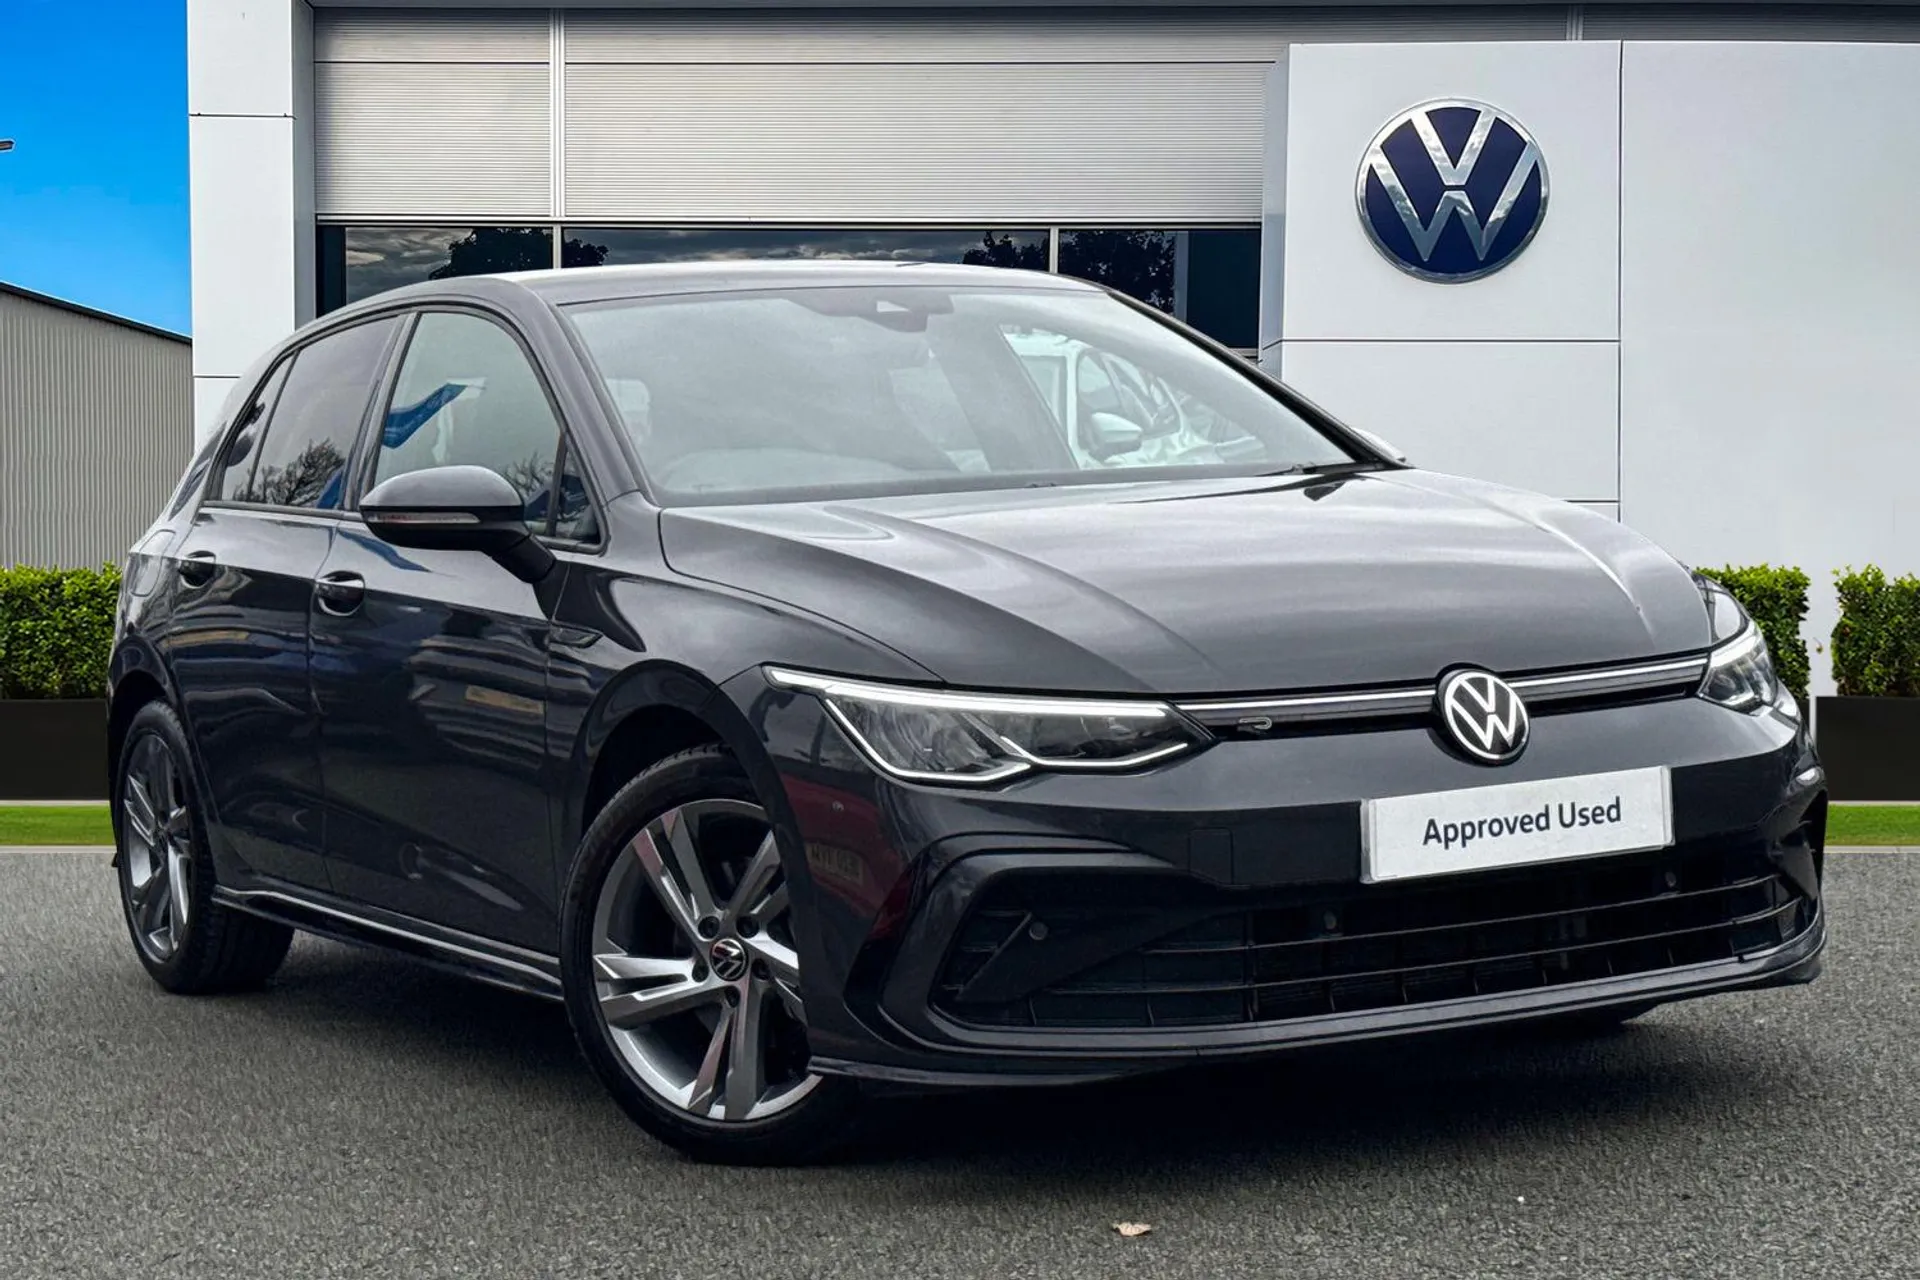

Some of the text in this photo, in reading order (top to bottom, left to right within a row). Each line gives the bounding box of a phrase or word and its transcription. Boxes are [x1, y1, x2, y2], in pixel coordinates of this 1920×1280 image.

[1362, 104, 1545, 270] VW
[1447, 673, 1525, 755] VW
[1423, 796, 1621, 850] Approved Used
